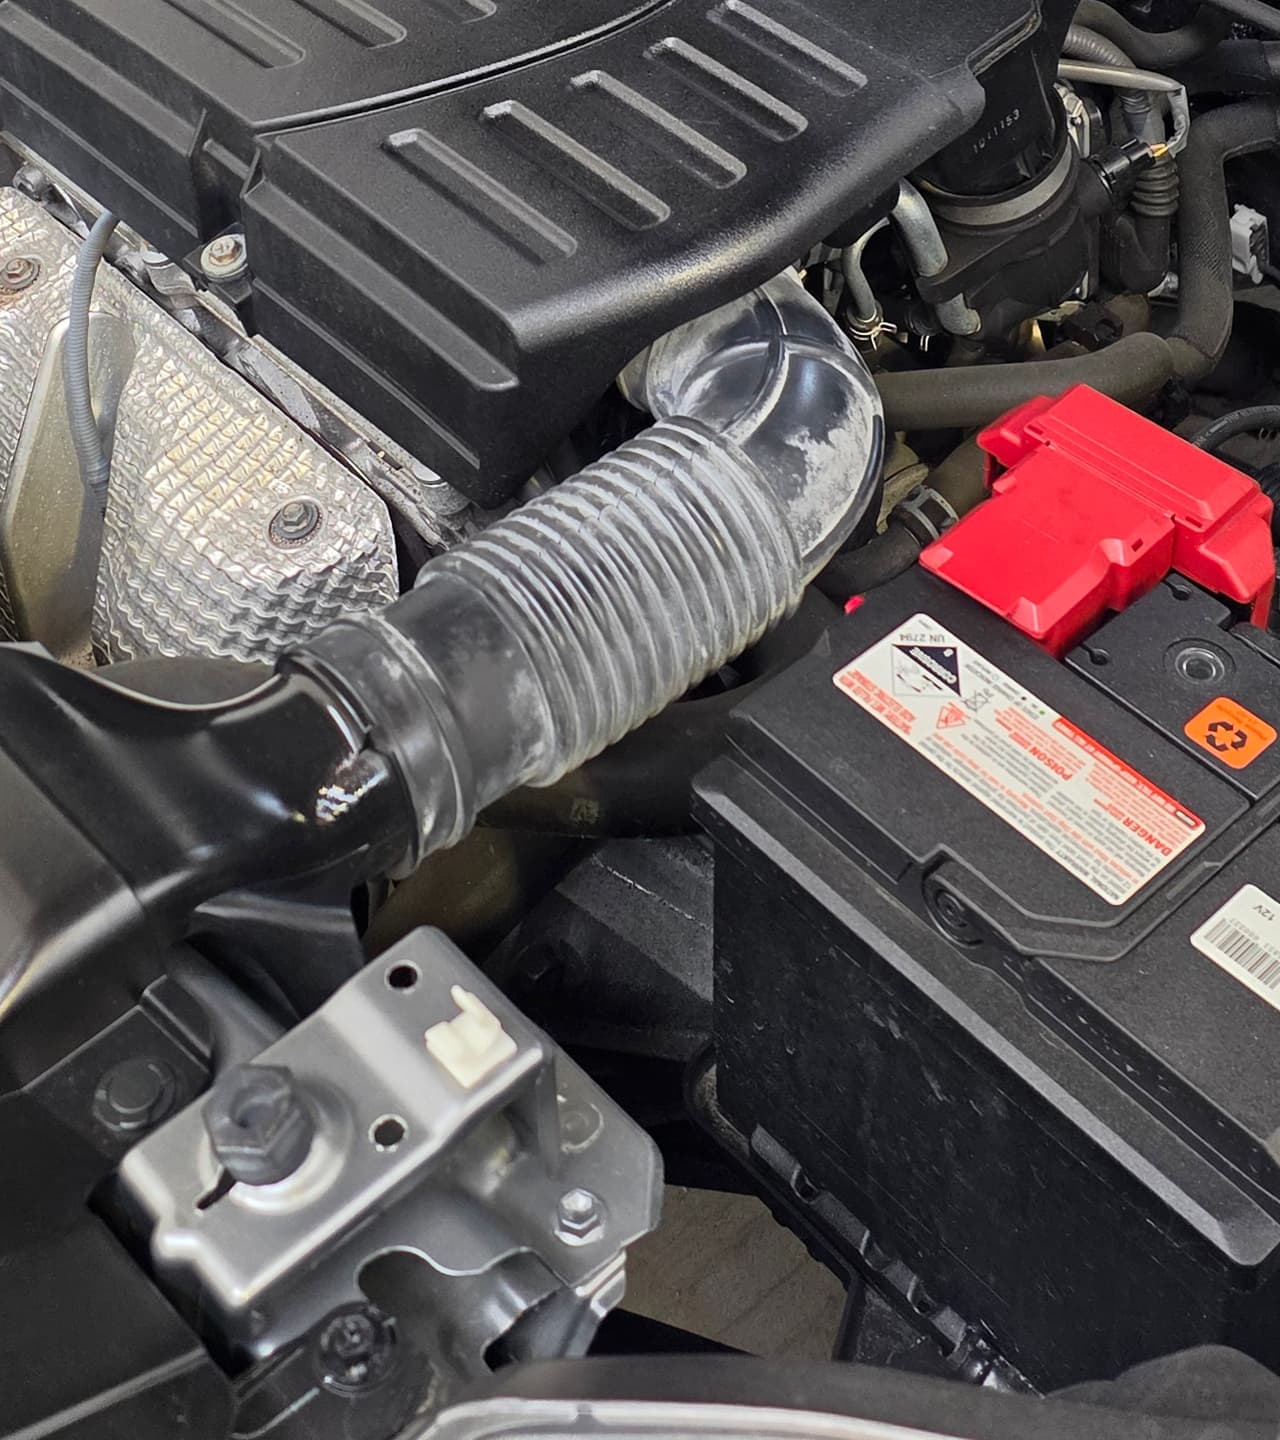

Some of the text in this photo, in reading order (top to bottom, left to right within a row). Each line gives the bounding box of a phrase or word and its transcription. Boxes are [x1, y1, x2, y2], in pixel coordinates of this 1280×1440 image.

[898, 632, 946, 644] UN 2794
[1027, 745, 1073, 781] POISON
[1120, 816, 1173, 857] DANGER
[1252, 901, 1276, 921] 12V
